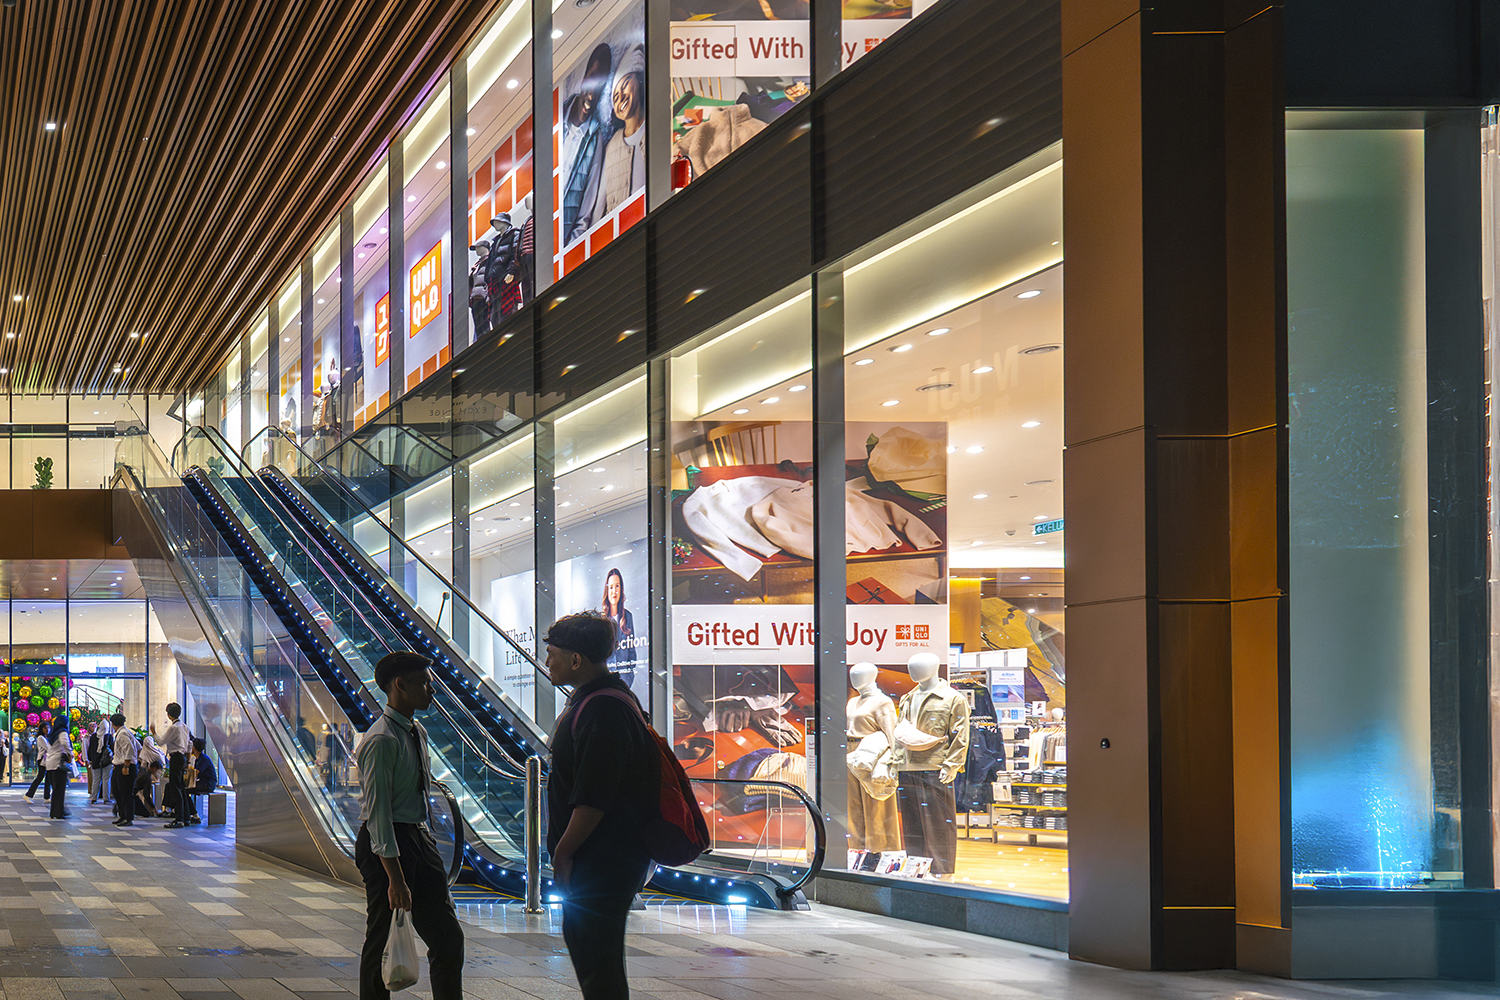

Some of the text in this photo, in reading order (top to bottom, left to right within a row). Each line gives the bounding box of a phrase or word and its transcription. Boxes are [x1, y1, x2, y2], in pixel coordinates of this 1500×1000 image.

[671, 37, 804, 60] Gifted With
[412, 255, 436, 297] UNI
[378, 303, 388, 330] ユ
[412, 284, 439, 328] QLO
[377, 329, 388, 358] ク
[687, 622, 888, 652] Gifted Wit Joy
